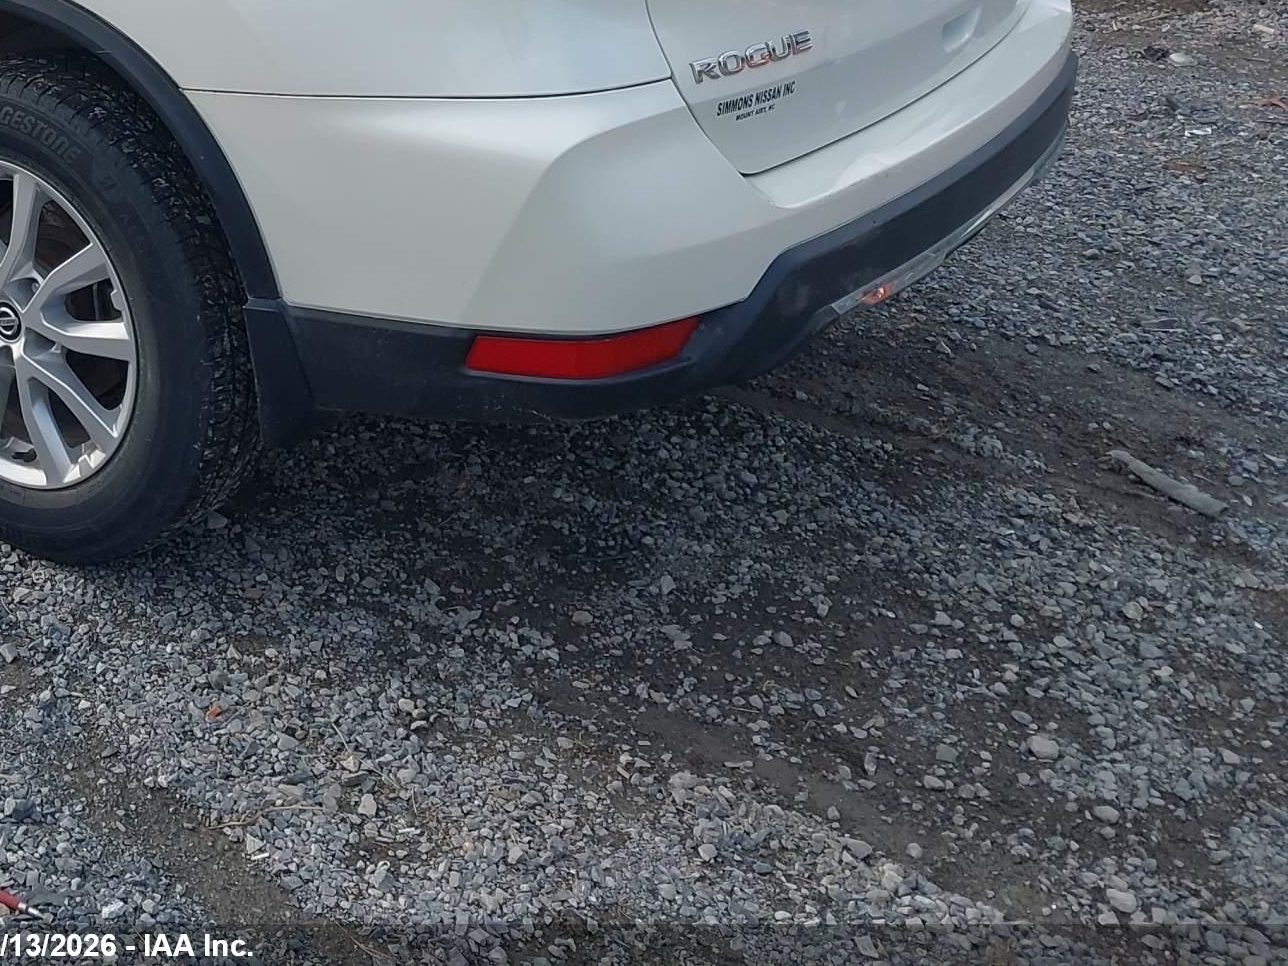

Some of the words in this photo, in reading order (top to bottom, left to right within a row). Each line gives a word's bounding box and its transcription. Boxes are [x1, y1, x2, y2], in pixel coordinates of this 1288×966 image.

[689, 30, 813, 84] ROGUE
[717, 94, 754, 116] SIMMONS
[754, 84, 782, 106] NISSAN
[782, 80, 796, 98] INC
